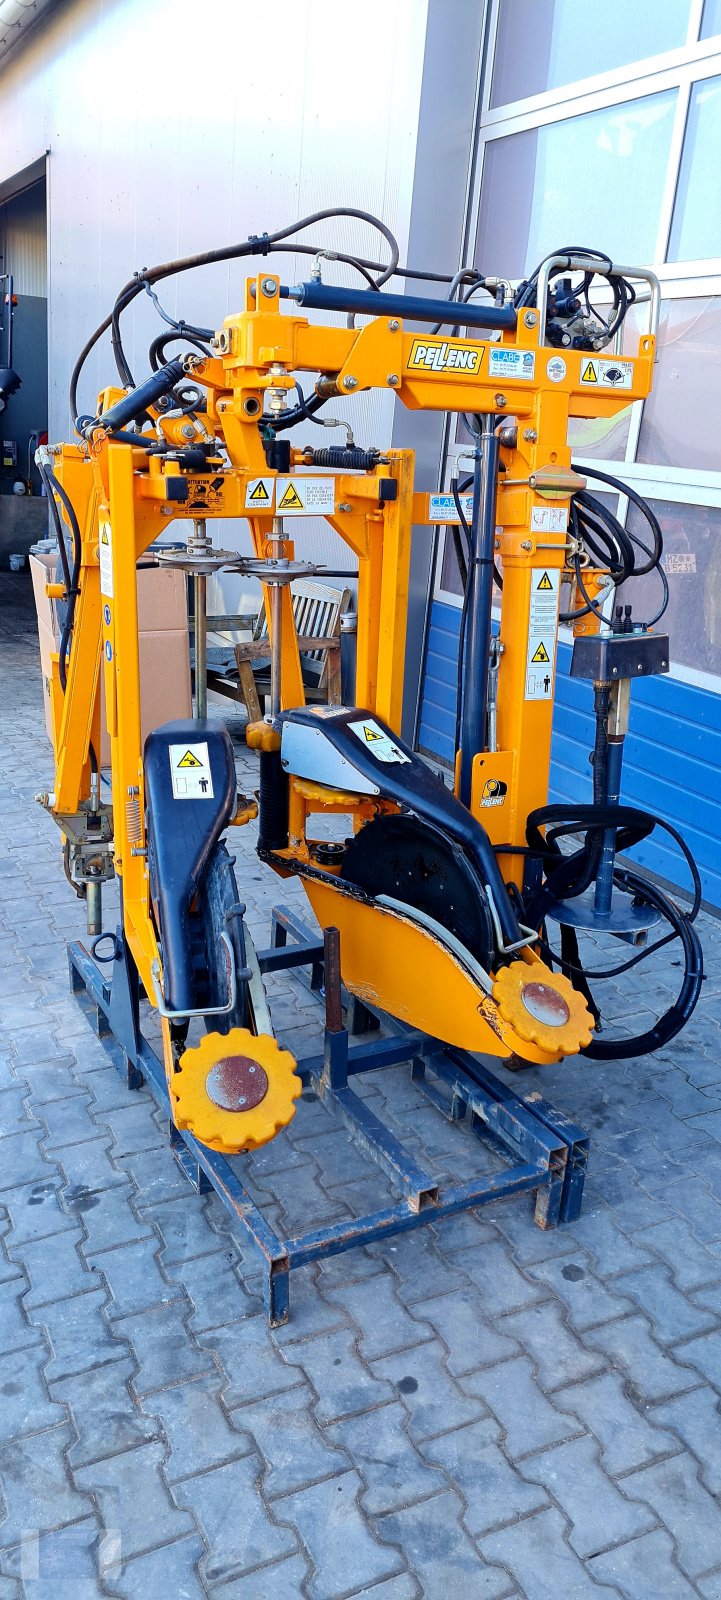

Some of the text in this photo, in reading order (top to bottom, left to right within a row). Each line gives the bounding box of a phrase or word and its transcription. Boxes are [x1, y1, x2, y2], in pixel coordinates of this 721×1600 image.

[414, 343, 477, 371] PELLENC
[491, 351, 520, 363] CLABE
[667, 555, 678, 563] MZ
[665, 564, 670, 572] B
